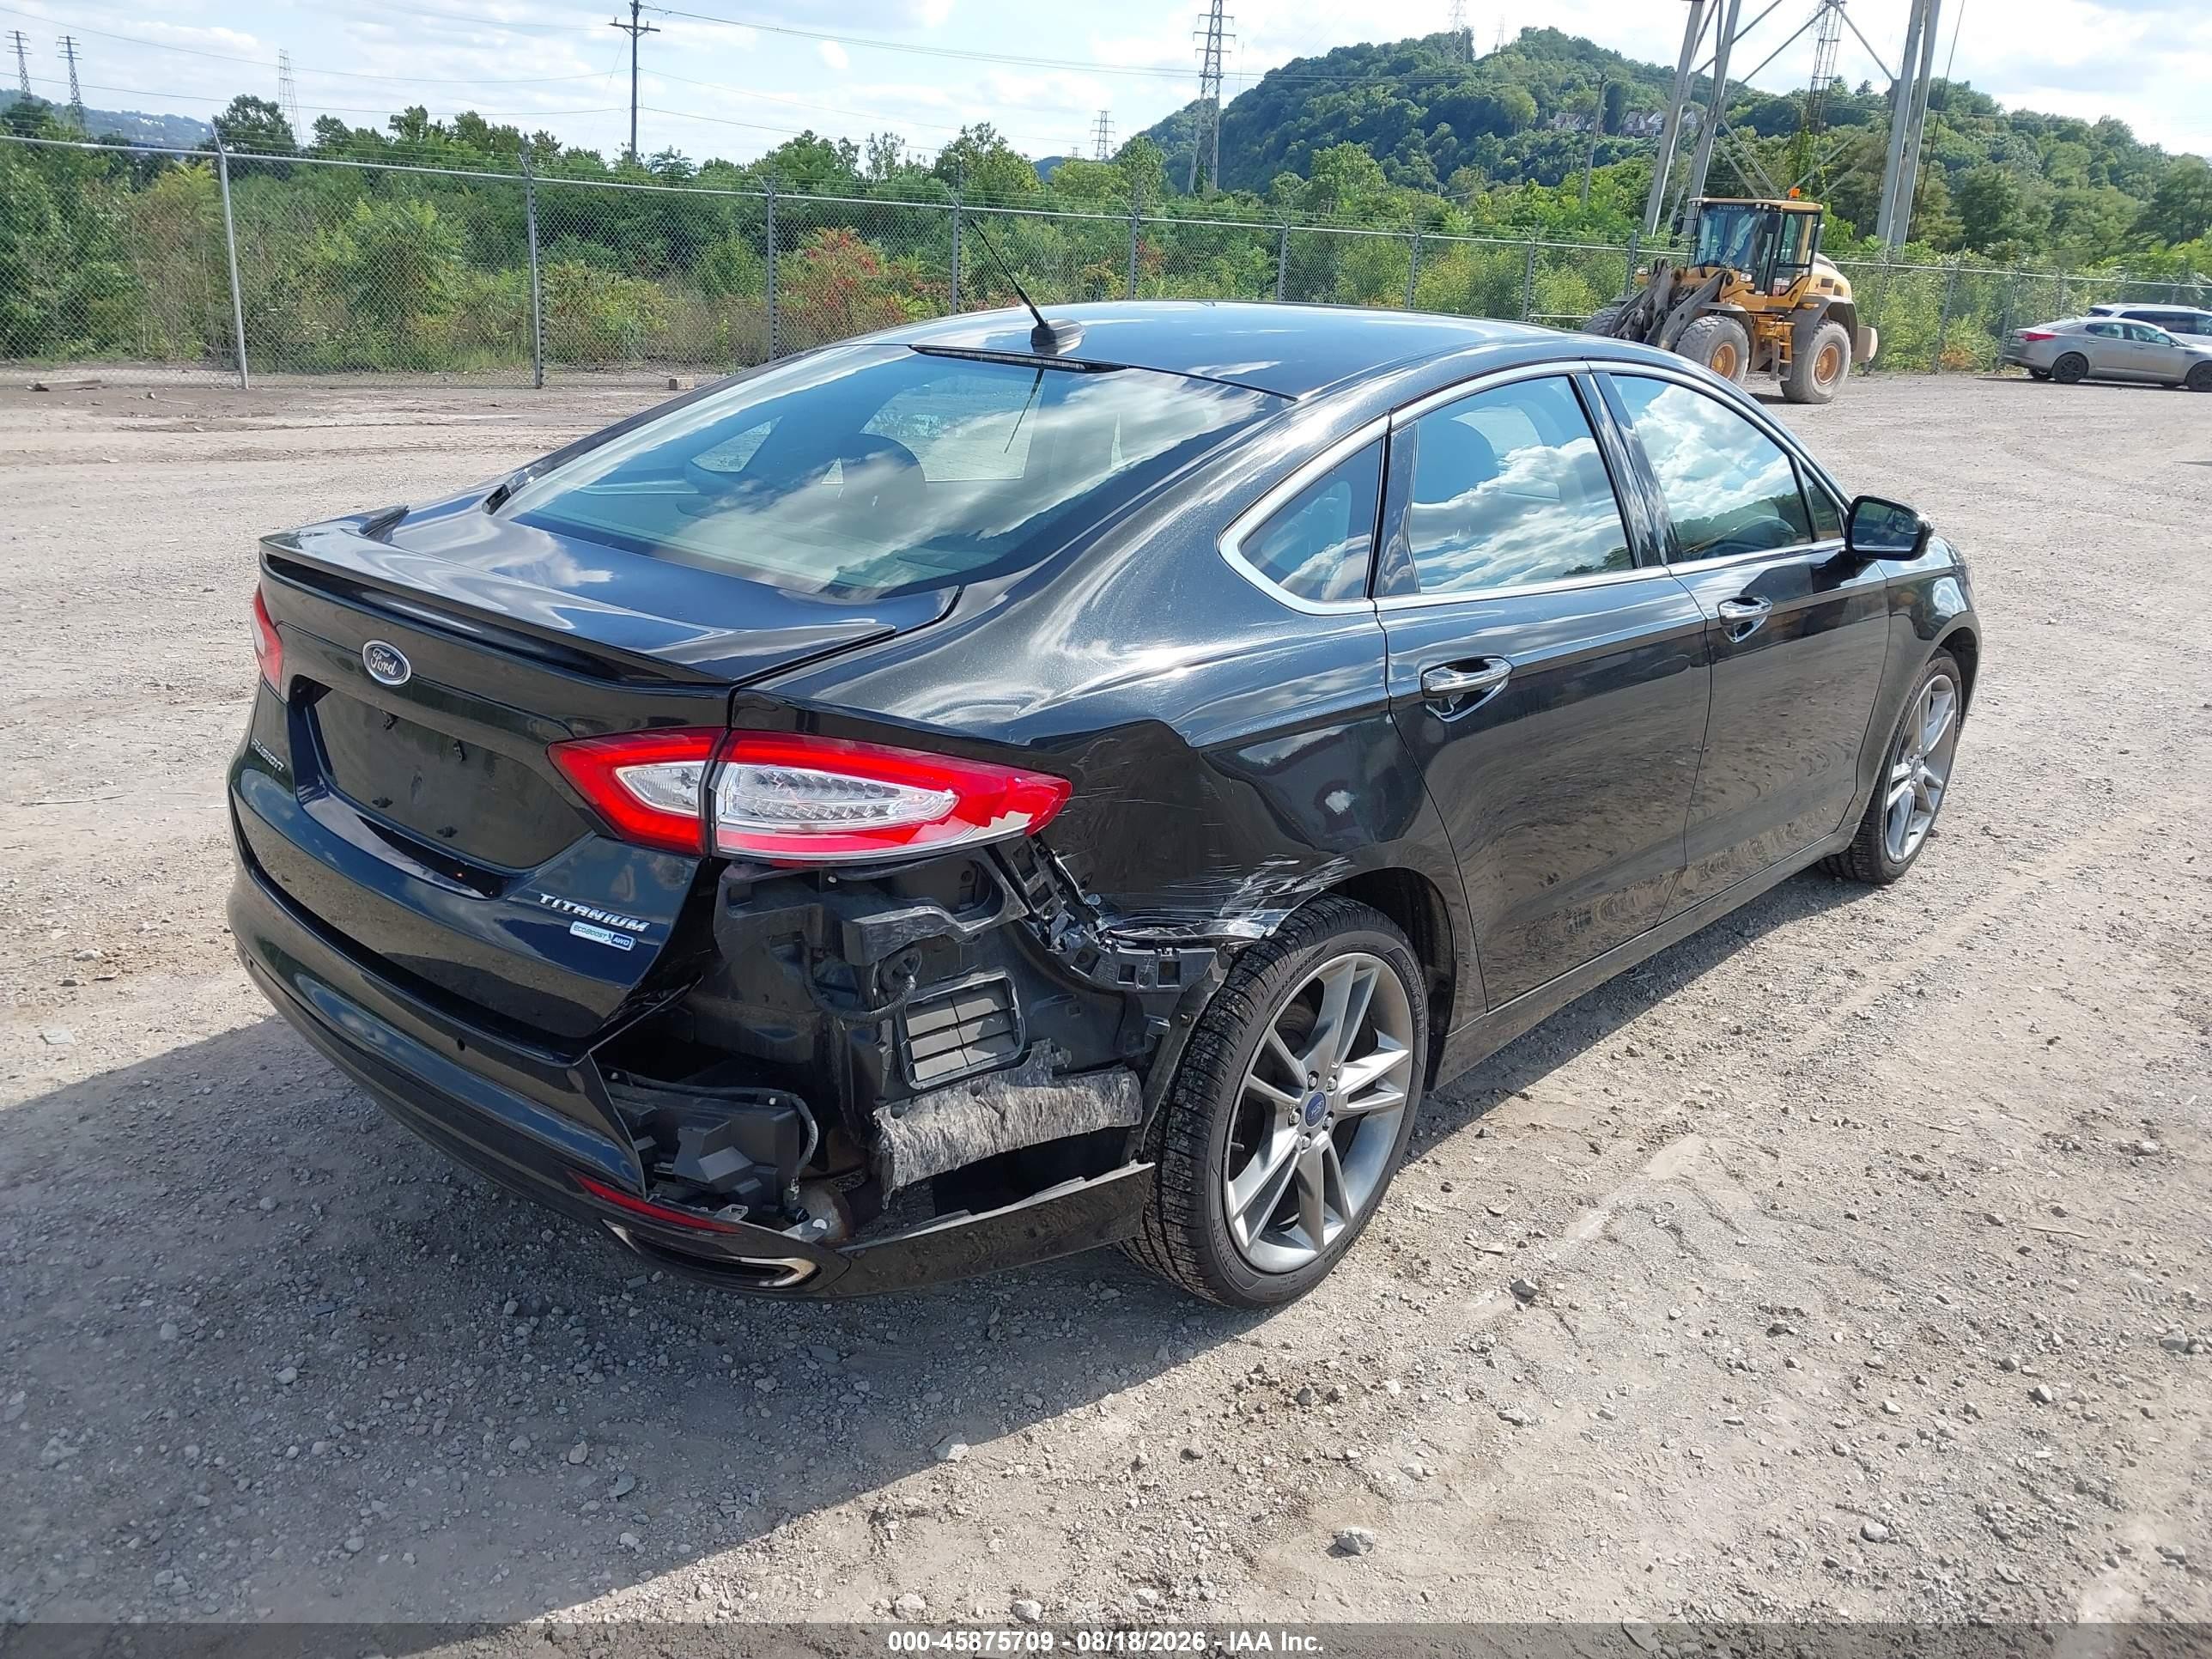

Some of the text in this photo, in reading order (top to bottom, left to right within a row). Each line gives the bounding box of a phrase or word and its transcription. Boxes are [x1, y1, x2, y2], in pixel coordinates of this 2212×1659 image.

[370, 647, 398, 676] Ford
[539, 893, 650, 933] TITANIUM
[612, 936, 630, 946] AWD
